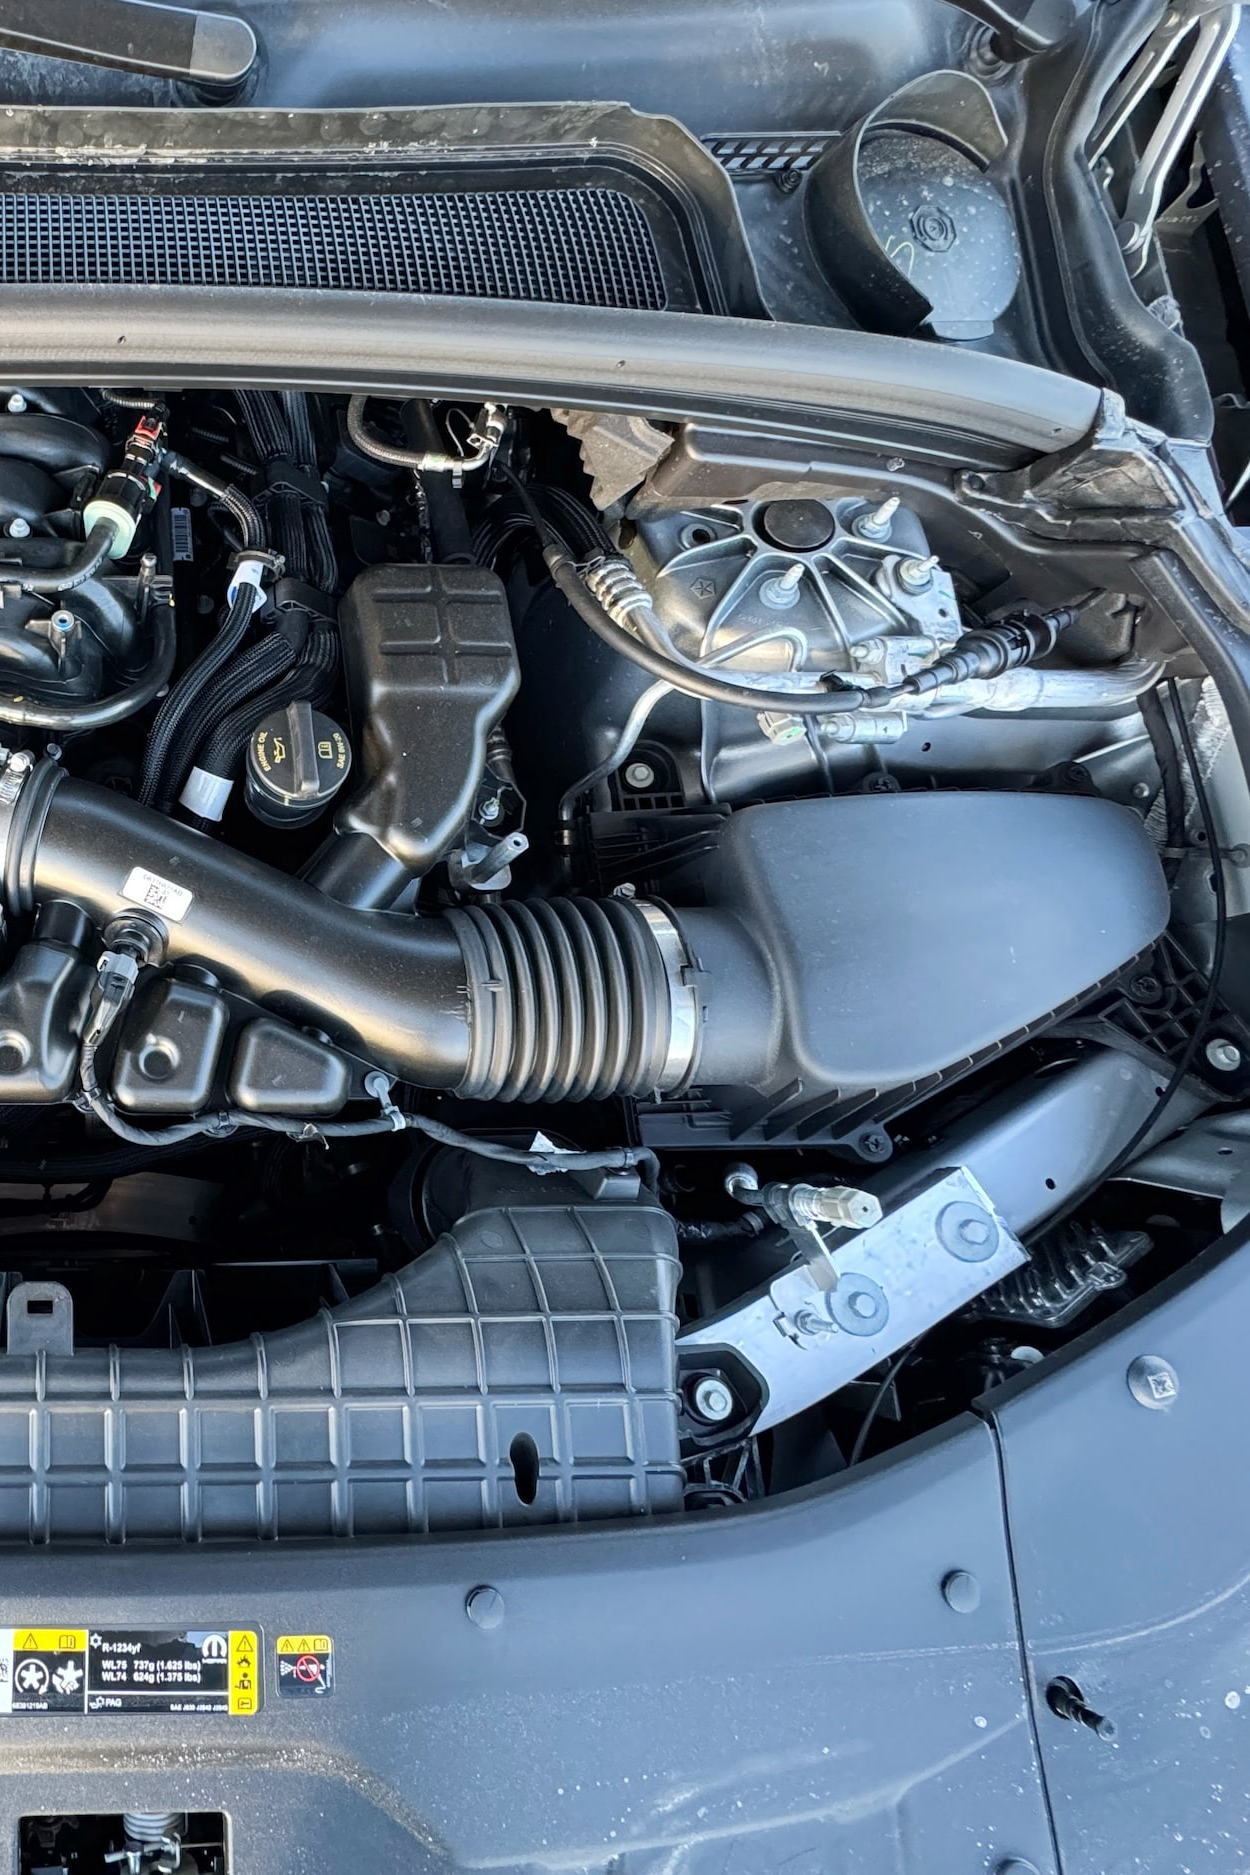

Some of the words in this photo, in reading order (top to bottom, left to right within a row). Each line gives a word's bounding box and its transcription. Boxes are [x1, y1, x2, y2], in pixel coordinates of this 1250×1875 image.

[258, 732, 268, 743] OIL
[257, 743, 272, 772] ENGINE
[336, 753, 346, 769] SAE
[102, 1642, 142, 1655] R-1234yf
[102, 1660, 128, 1671] WL75
[133, 1660, 155, 1672] 737g
[156, 1660, 183, 1672] (1.625
[184, 1660, 201, 1672] lbs)
[102, 1672, 127, 1682] WL74
[133, 1672, 155, 1684] 624g
[156, 1672, 183, 1684] (1.375
[184, 1672, 201, 1684] lbs)
[105, 1698, 122, 1708] PAG
